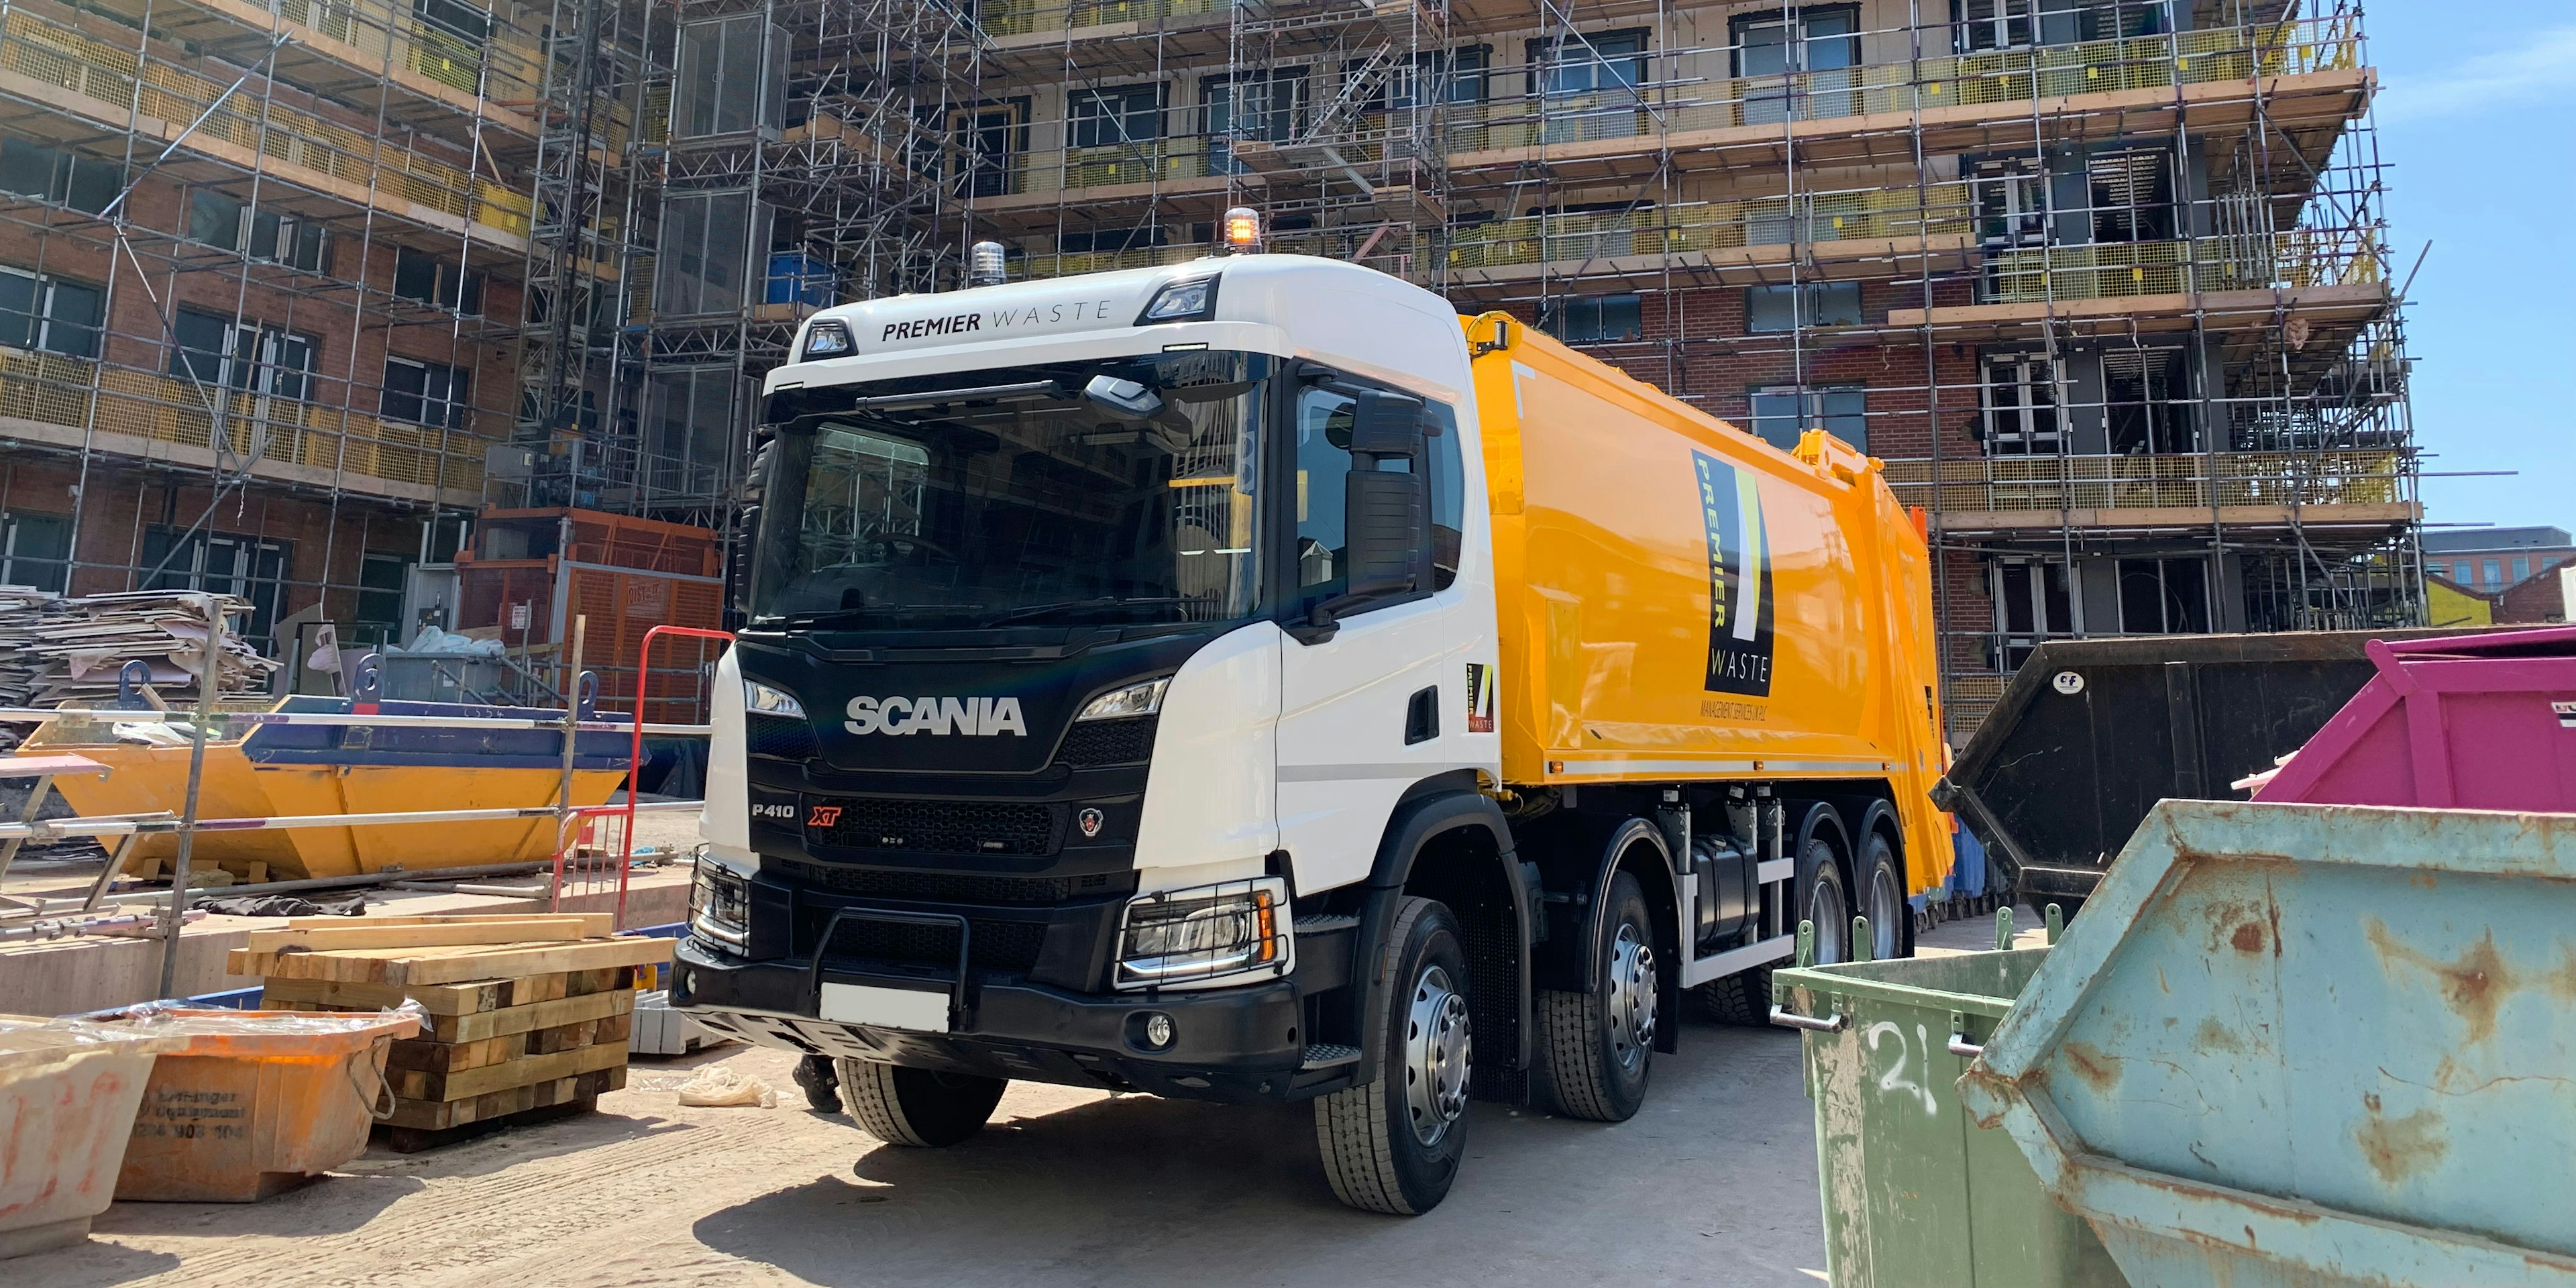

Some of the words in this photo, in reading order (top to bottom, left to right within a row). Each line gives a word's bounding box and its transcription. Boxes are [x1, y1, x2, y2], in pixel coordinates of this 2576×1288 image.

[882, 313, 981, 341] PREMIER
[994, 301, 1111, 327] WASTE
[1698, 458, 1725, 628] PREMIER
[1712, 648, 1768, 682] WASTE
[845, 696, 1028, 736] SCANIA
[1469, 720, 1493, 729] WASTE
[807, 806, 843, 826] XT
[1868, 1021, 1937, 1116] 21
